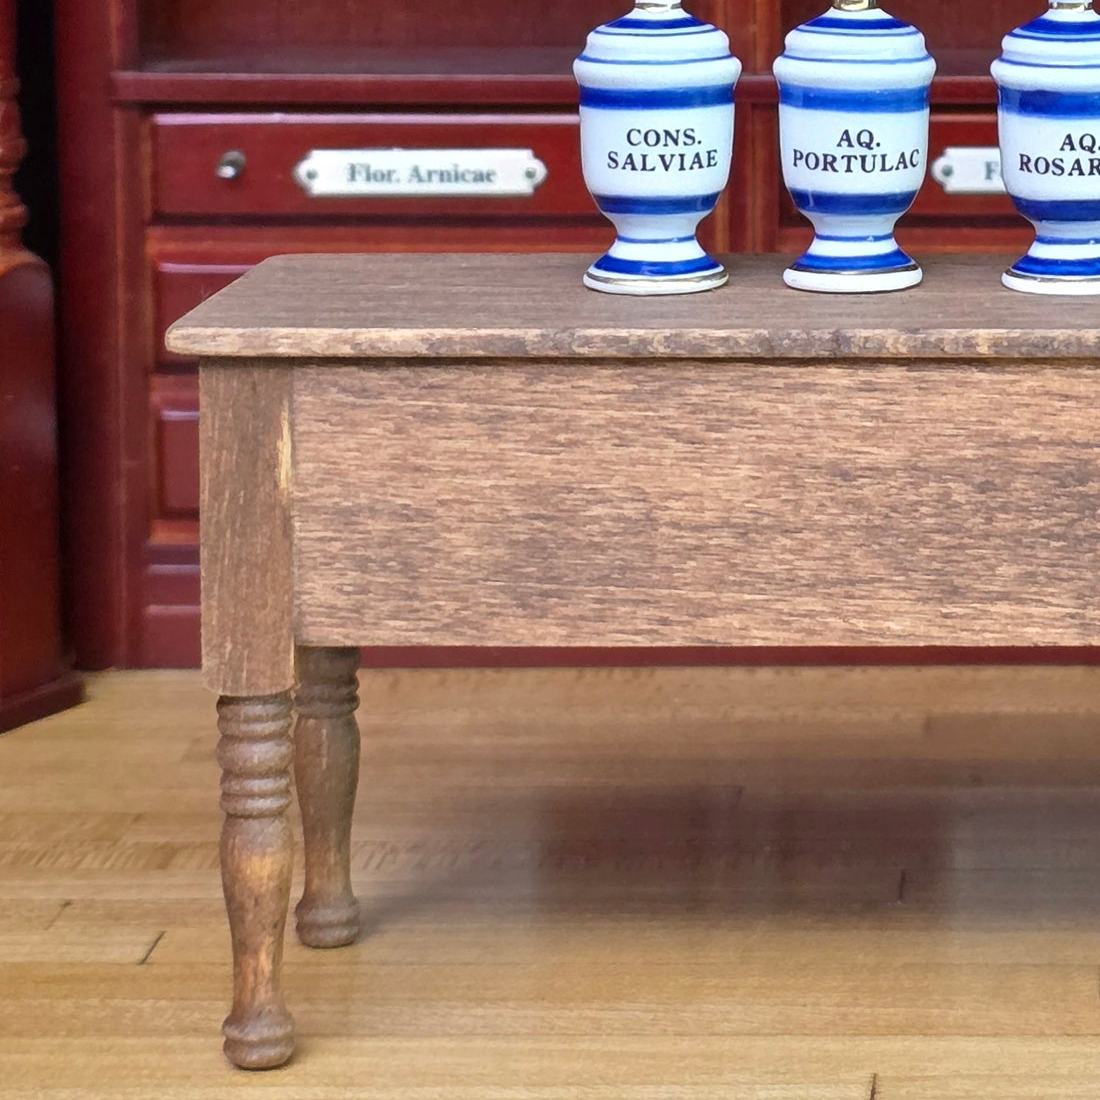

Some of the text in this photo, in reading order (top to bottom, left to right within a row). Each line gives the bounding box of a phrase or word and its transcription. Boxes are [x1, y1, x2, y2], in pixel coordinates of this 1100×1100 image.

[626, 128, 702, 147] CONS.
[837, 129, 881, 148] AQ.
[606, 149, 718, 173] SALVIAE
[791, 149, 920, 174] PORTULAC
[346, 162, 498, 183] Flor. Arnicae
